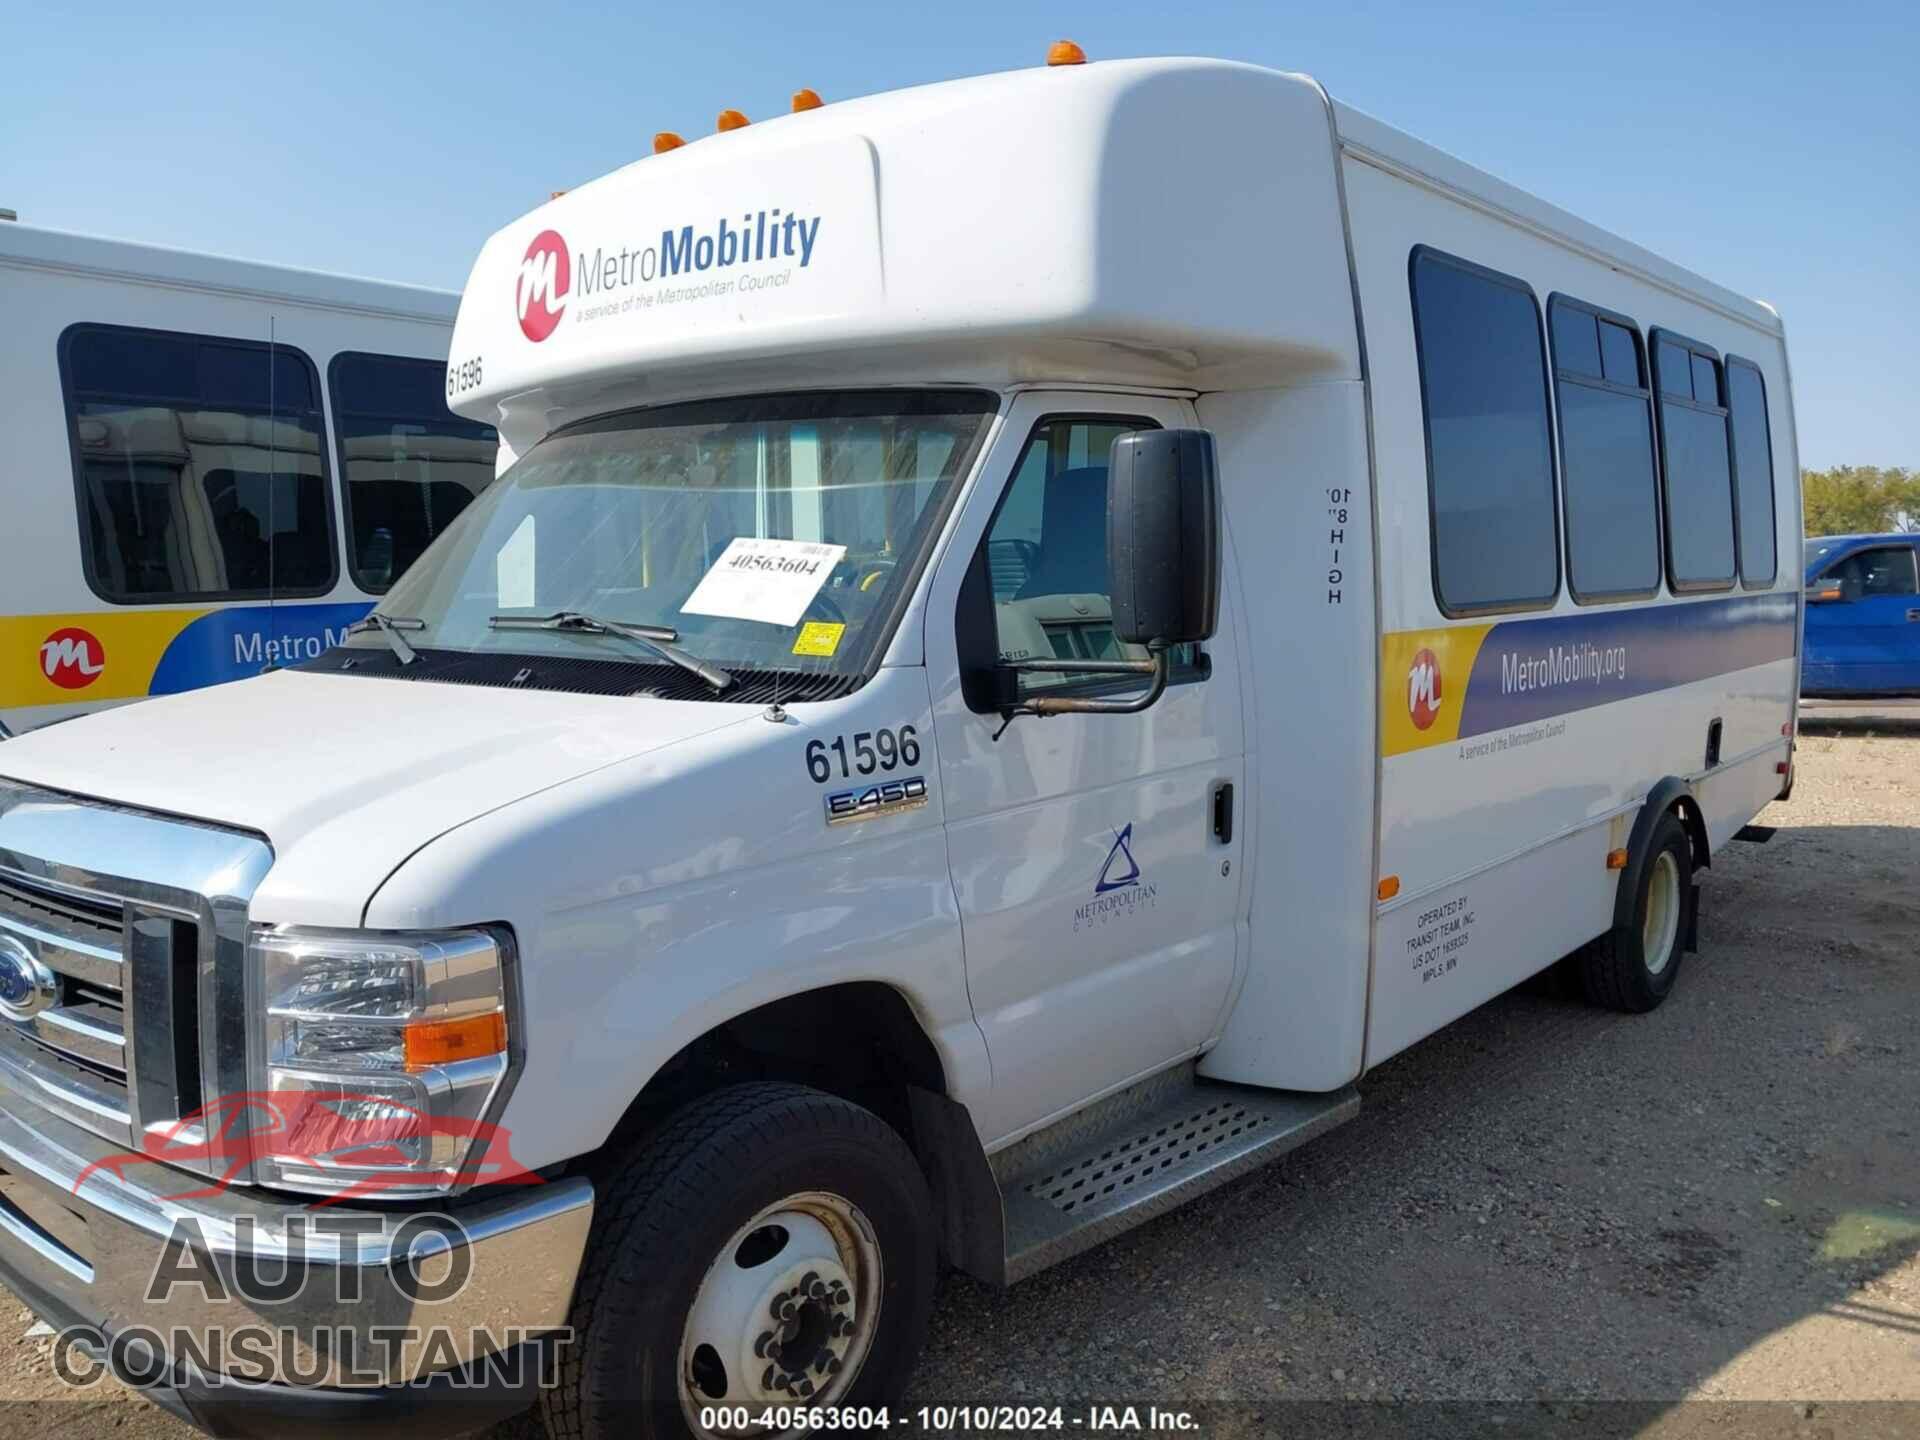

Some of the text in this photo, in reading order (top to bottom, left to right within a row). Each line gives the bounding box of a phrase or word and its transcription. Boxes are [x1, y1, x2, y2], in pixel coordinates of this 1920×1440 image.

[576, 208, 821, 297] MetroMobility
[584, 302, 620, 322] service
[621, 297, 635, 313] of
[636, 292, 654, 310] the
[656, 278, 735, 305] Metropolitan
[738, 268, 792, 292] Council
[447, 355, 483, 396] 61596
[728, 553, 821, 577] 40563604
[1501, 641, 1626, 695] MetroMobility.org
[805, 724, 921, 784] 61596
[1073, 885, 1157, 921] METROPOLITAN
[1417, 896, 1468, 929] OPERATED BY
[1407, 928, 1439, 954] TRANSIT
[1412, 954, 1423, 970] US
[1424, 945, 1440, 964] DOT
